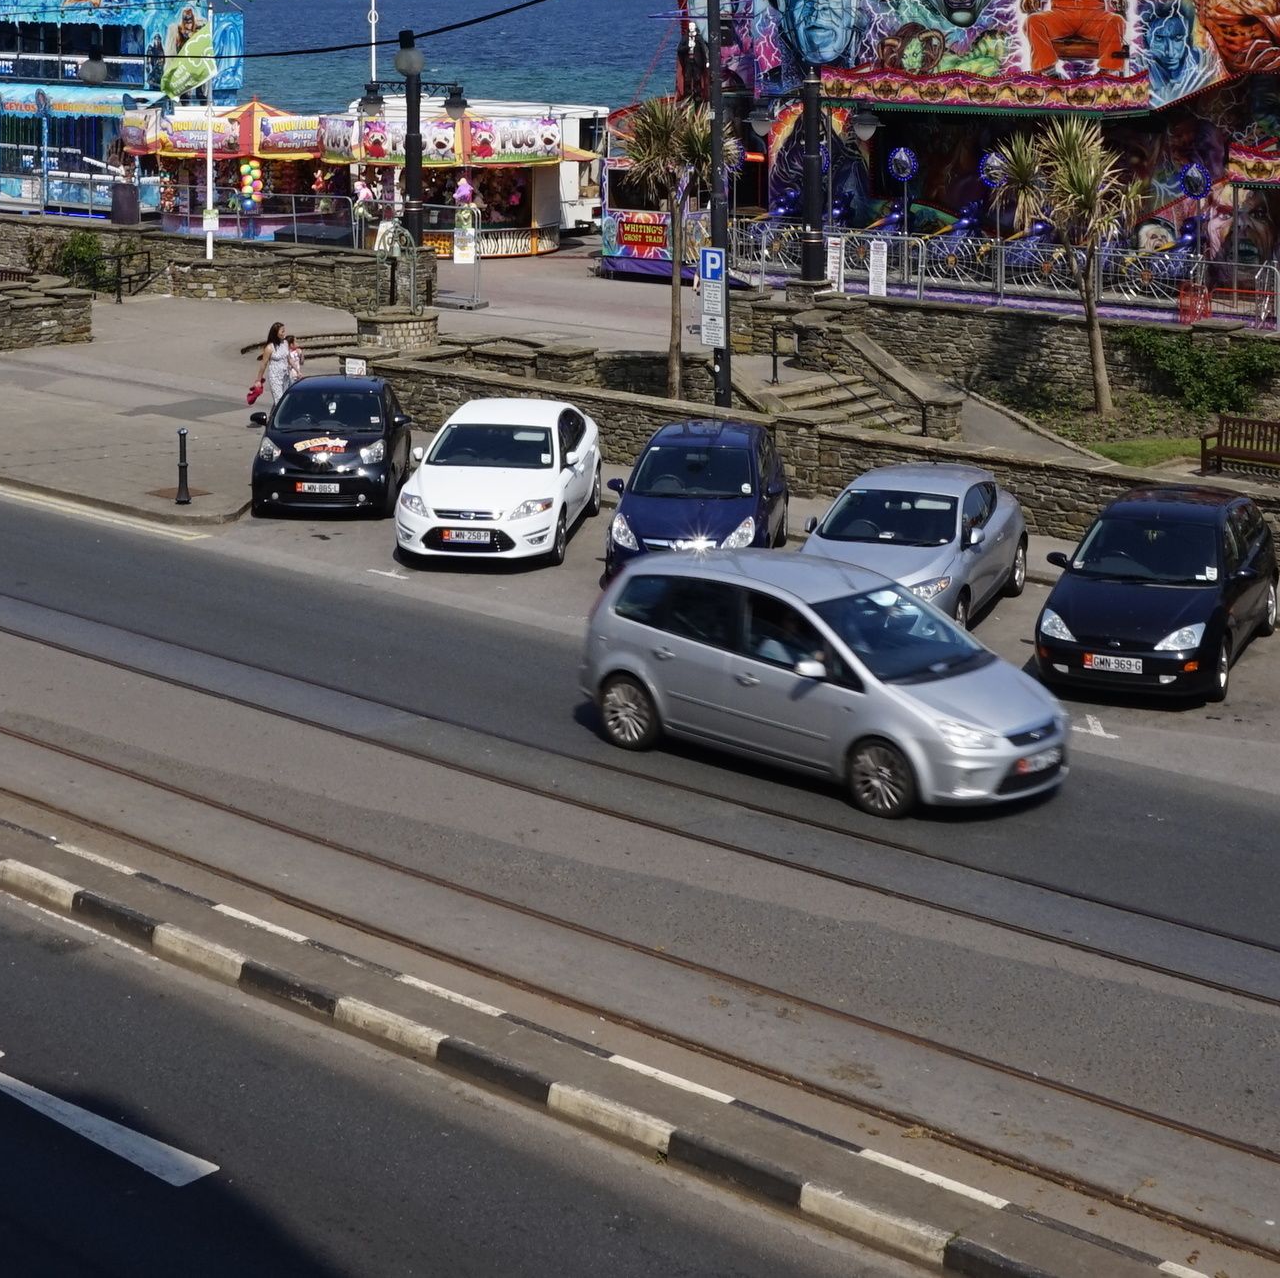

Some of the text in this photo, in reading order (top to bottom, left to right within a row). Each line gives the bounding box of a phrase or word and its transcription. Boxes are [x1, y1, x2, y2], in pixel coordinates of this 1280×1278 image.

[501, 127, 536, 152] PUG
[623, 223, 664, 234] WHITING'S
[705, 251, 721, 279] P
[1093, 656, 1142, 672] GMN-969-G
